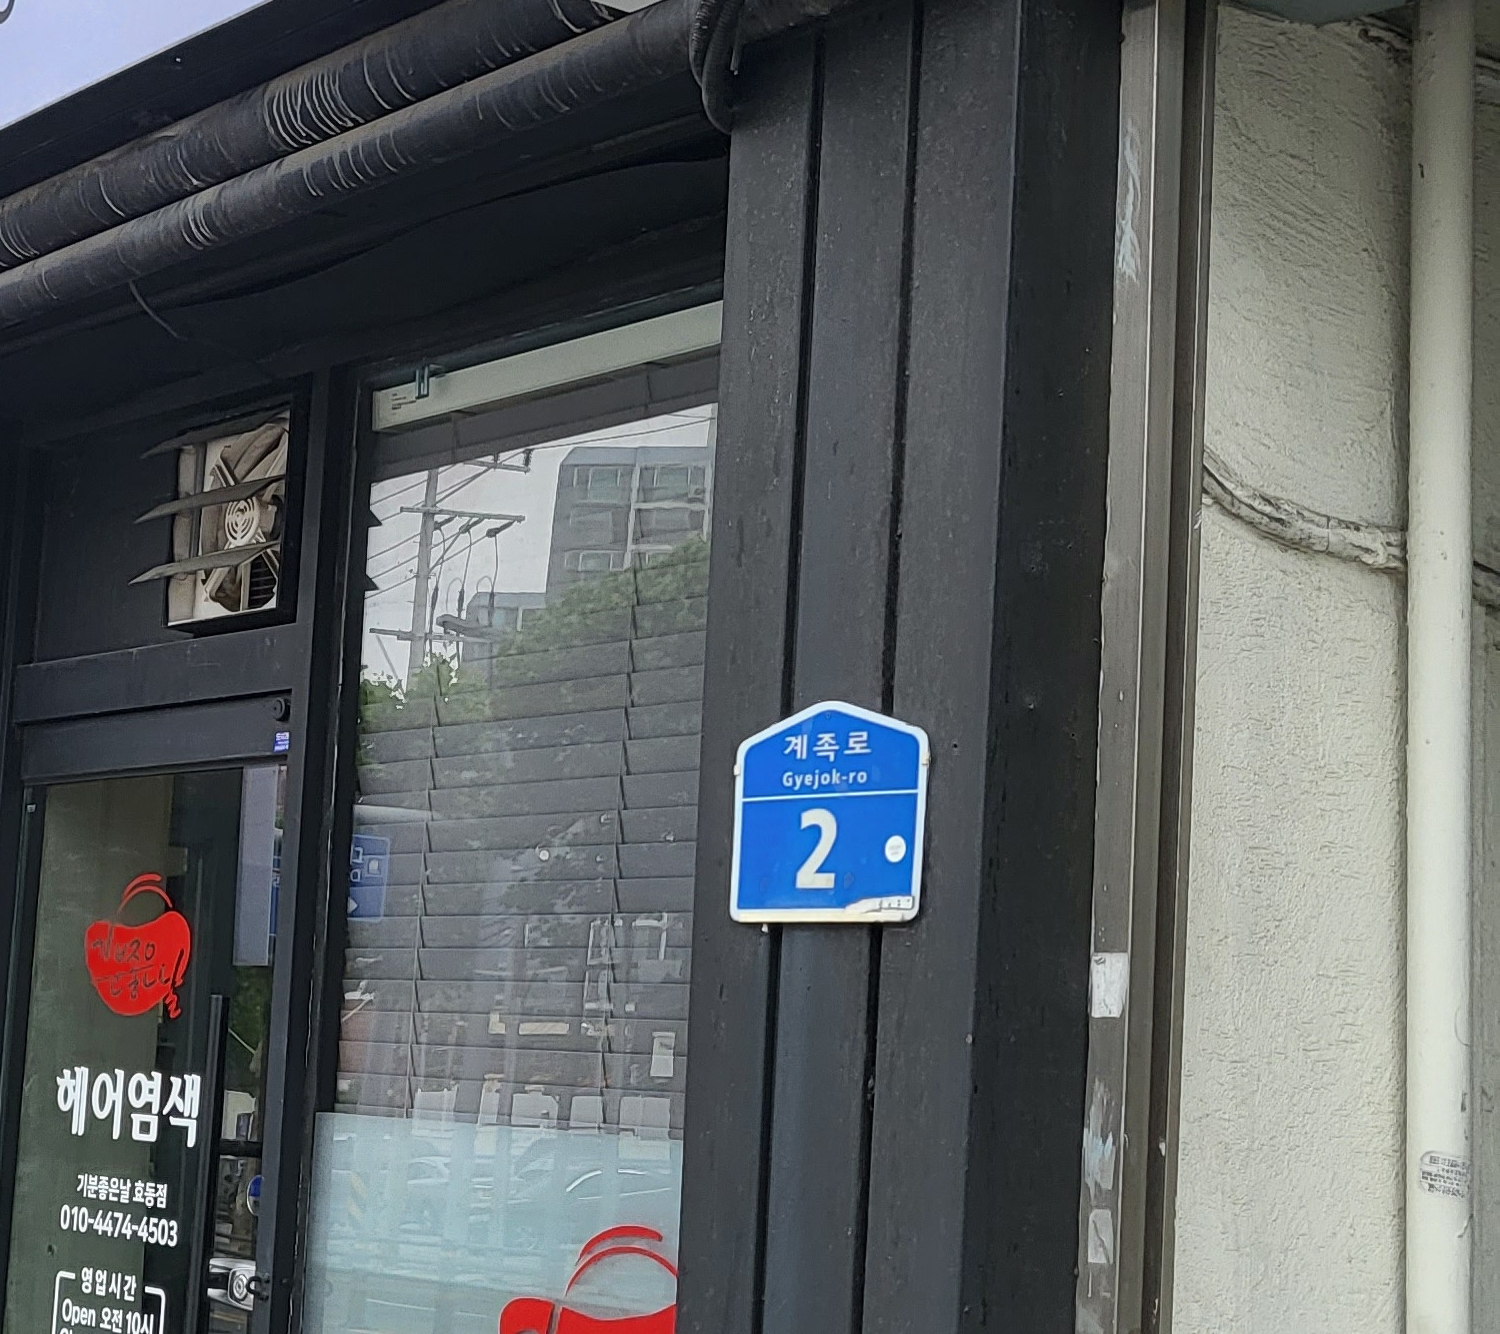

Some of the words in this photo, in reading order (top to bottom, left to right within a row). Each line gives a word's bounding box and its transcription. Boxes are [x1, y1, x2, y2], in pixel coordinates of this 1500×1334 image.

[784, 730, 873, 762] 계족로
[782, 768, 868, 790] Gyejok-ro
[795, 807, 838, 889] 2
[56, 1066, 201, 1148] 헤어염색
[76, 1173, 132, 1204] 기분좋은날
[132, 1179, 168, 1209] 효동점
[60, 1204, 178, 1247] 010-4474-4503
[81, 1267, 137, 1302] 영업시간
[62, 1298, 96, 1328] Open
[99, 1307, 123, 1334] 오전
